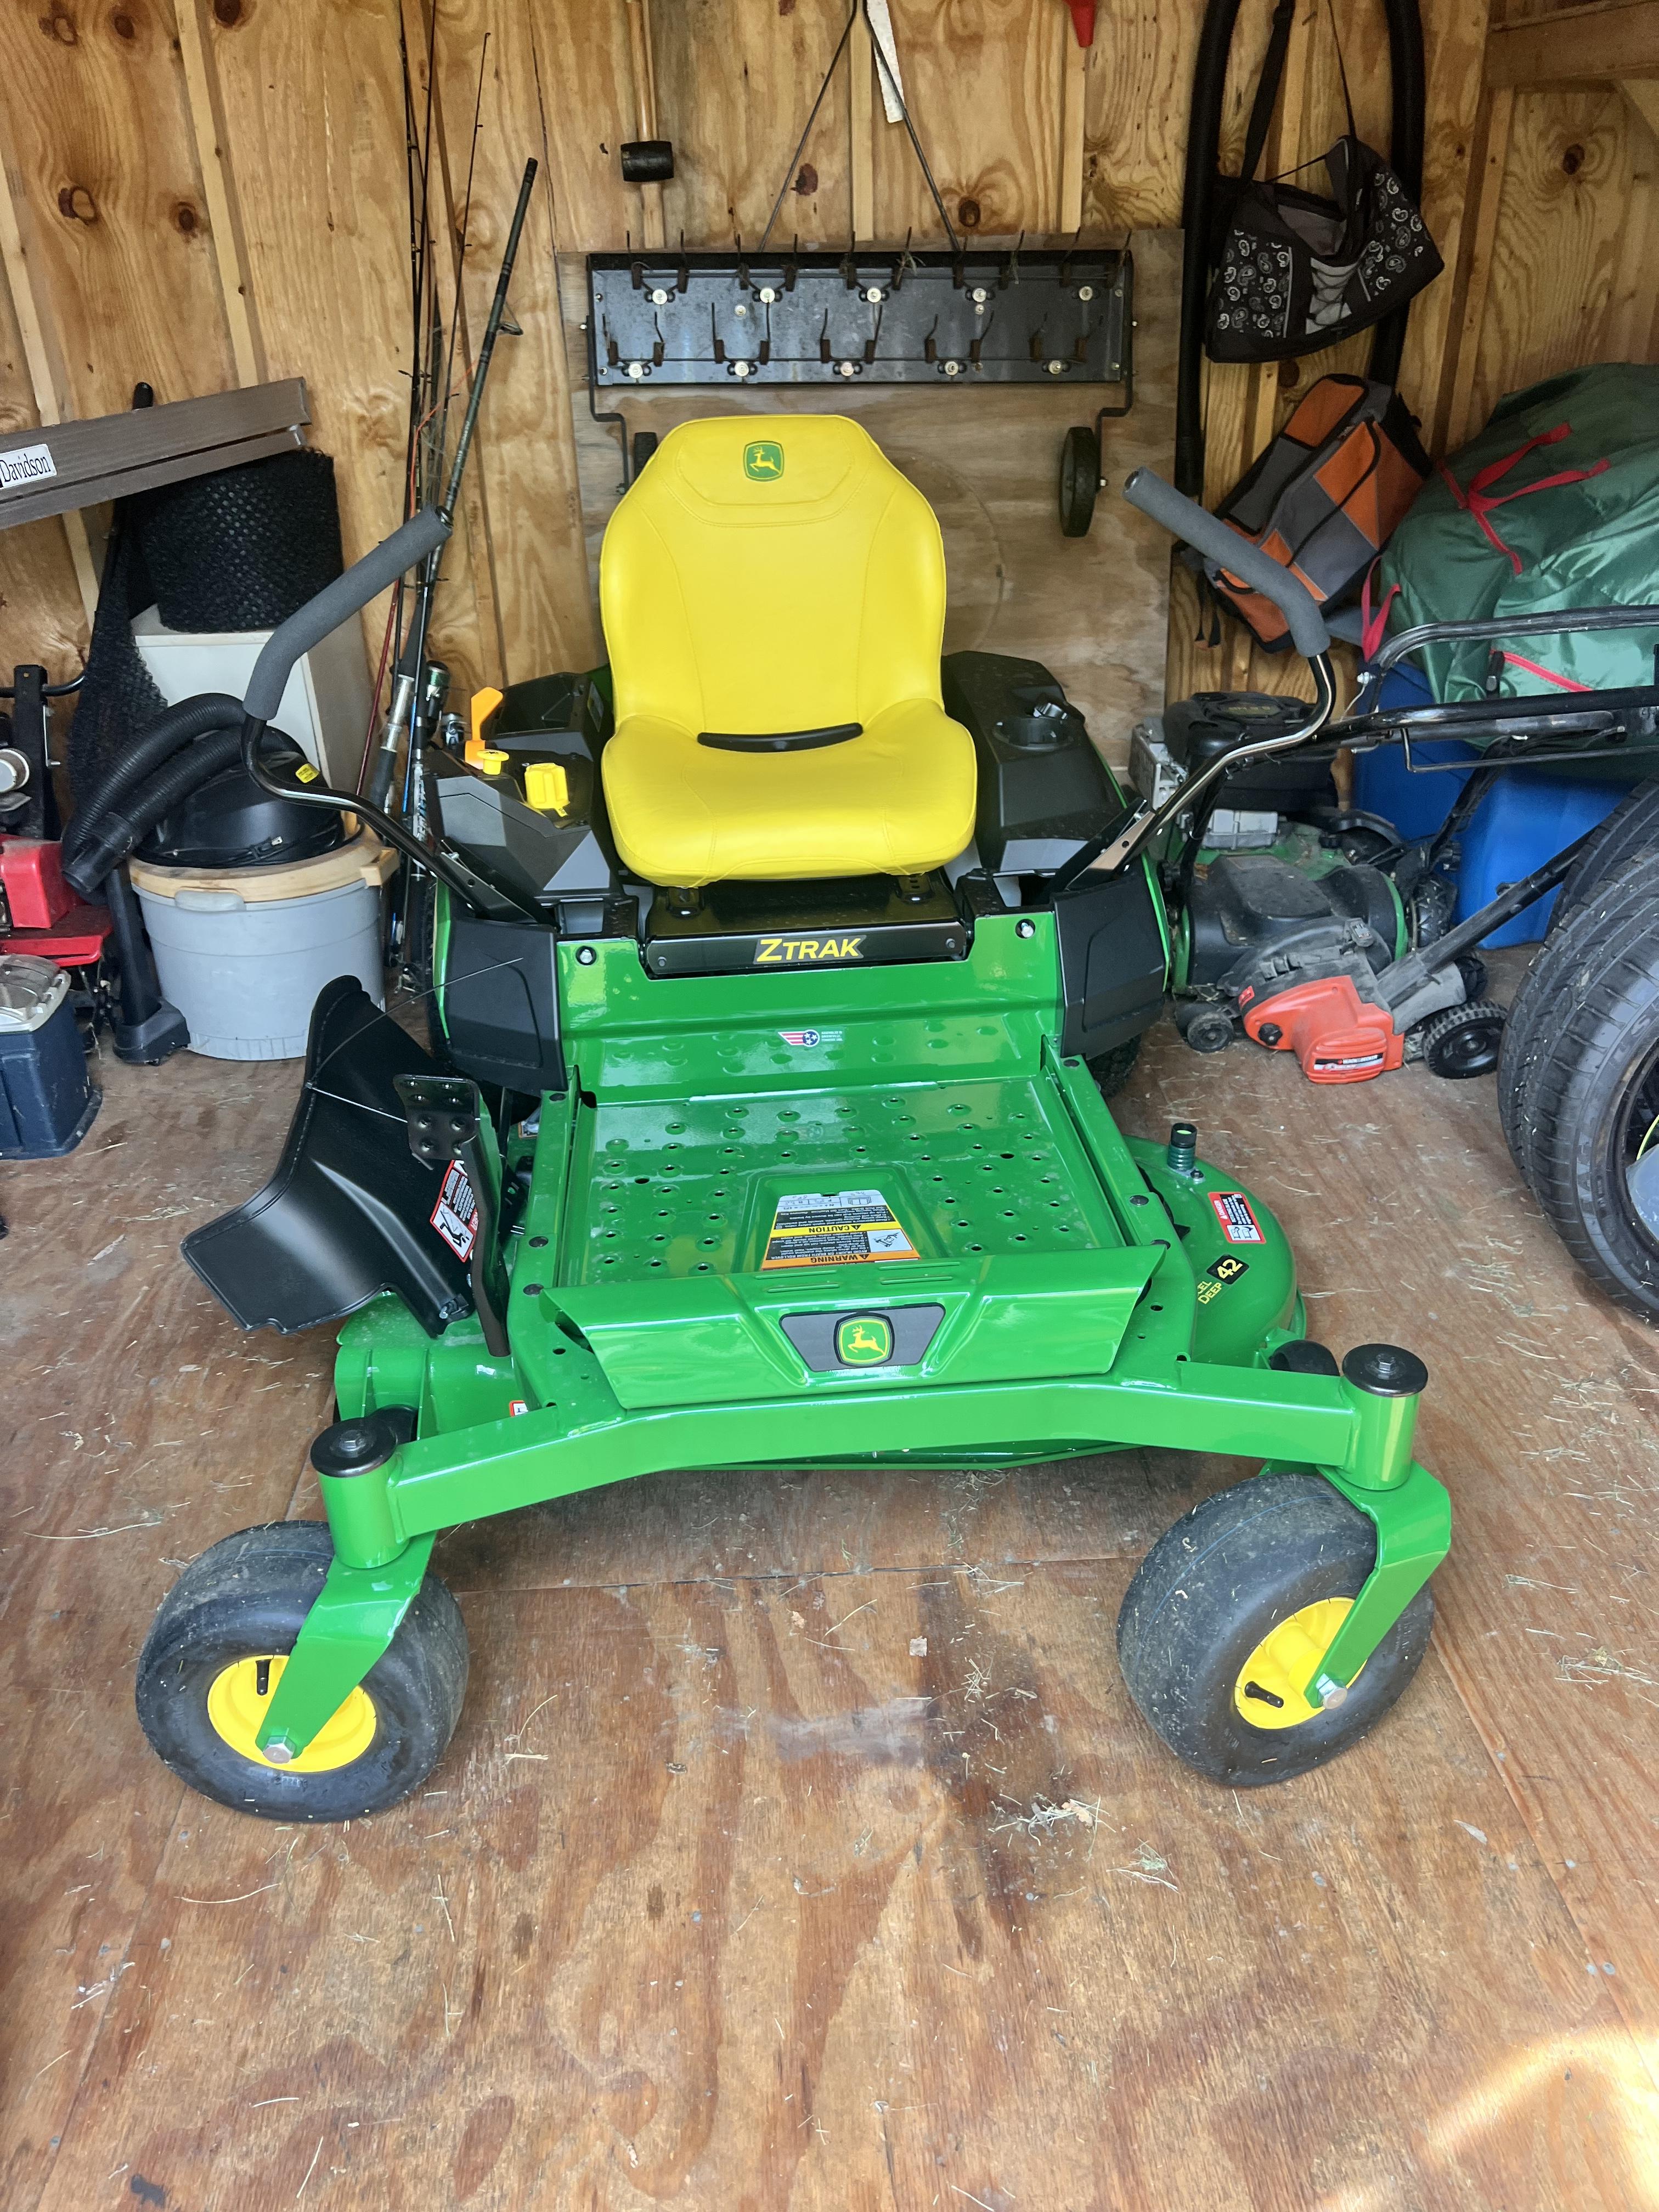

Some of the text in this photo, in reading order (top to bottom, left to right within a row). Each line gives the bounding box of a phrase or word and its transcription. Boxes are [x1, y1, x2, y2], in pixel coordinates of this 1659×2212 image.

[0, 453, 50, 482] Davidson
[757, 938, 861, 962] ZTRAK
[810, 1254, 858, 1263] WARNING
[1217, 1259, 1243, 1279] 42
[1198, 1282, 1222, 1305] DEEP
